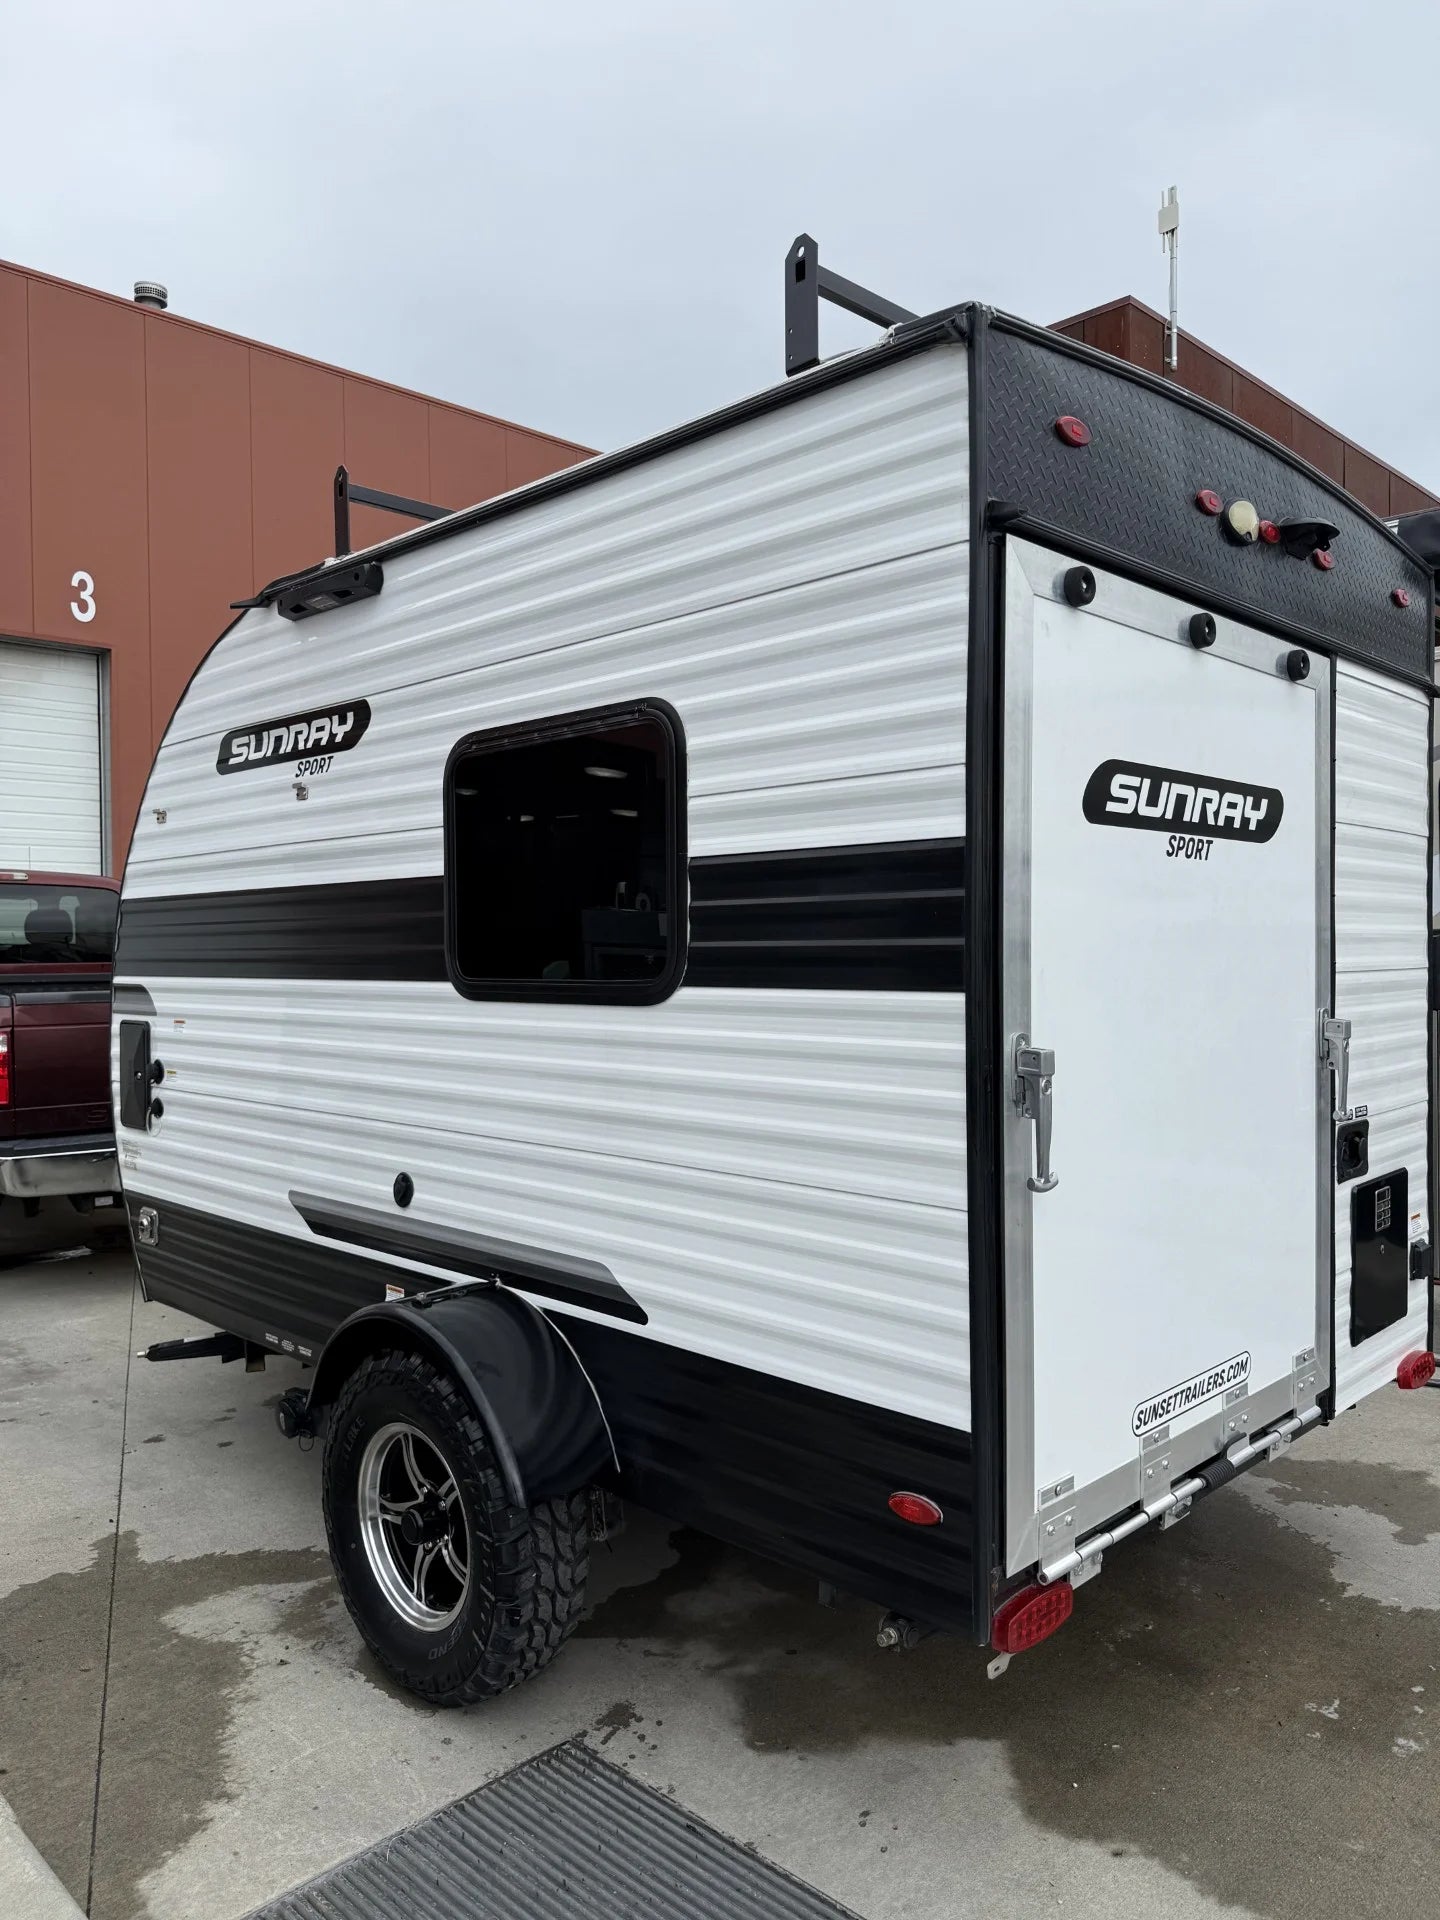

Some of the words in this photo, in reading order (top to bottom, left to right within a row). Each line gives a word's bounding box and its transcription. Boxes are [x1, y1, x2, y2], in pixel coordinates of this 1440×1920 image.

[70, 570, 96, 623] 3
[228, 711, 354, 765] SUNRAY
[295, 755, 334, 778] SPORT
[1105, 773, 1268, 831] SUNRAY
[1166, 834, 1214, 861] SPORT
[1135, 1356, 1249, 1430] SUNSETTRAILERS.COM
